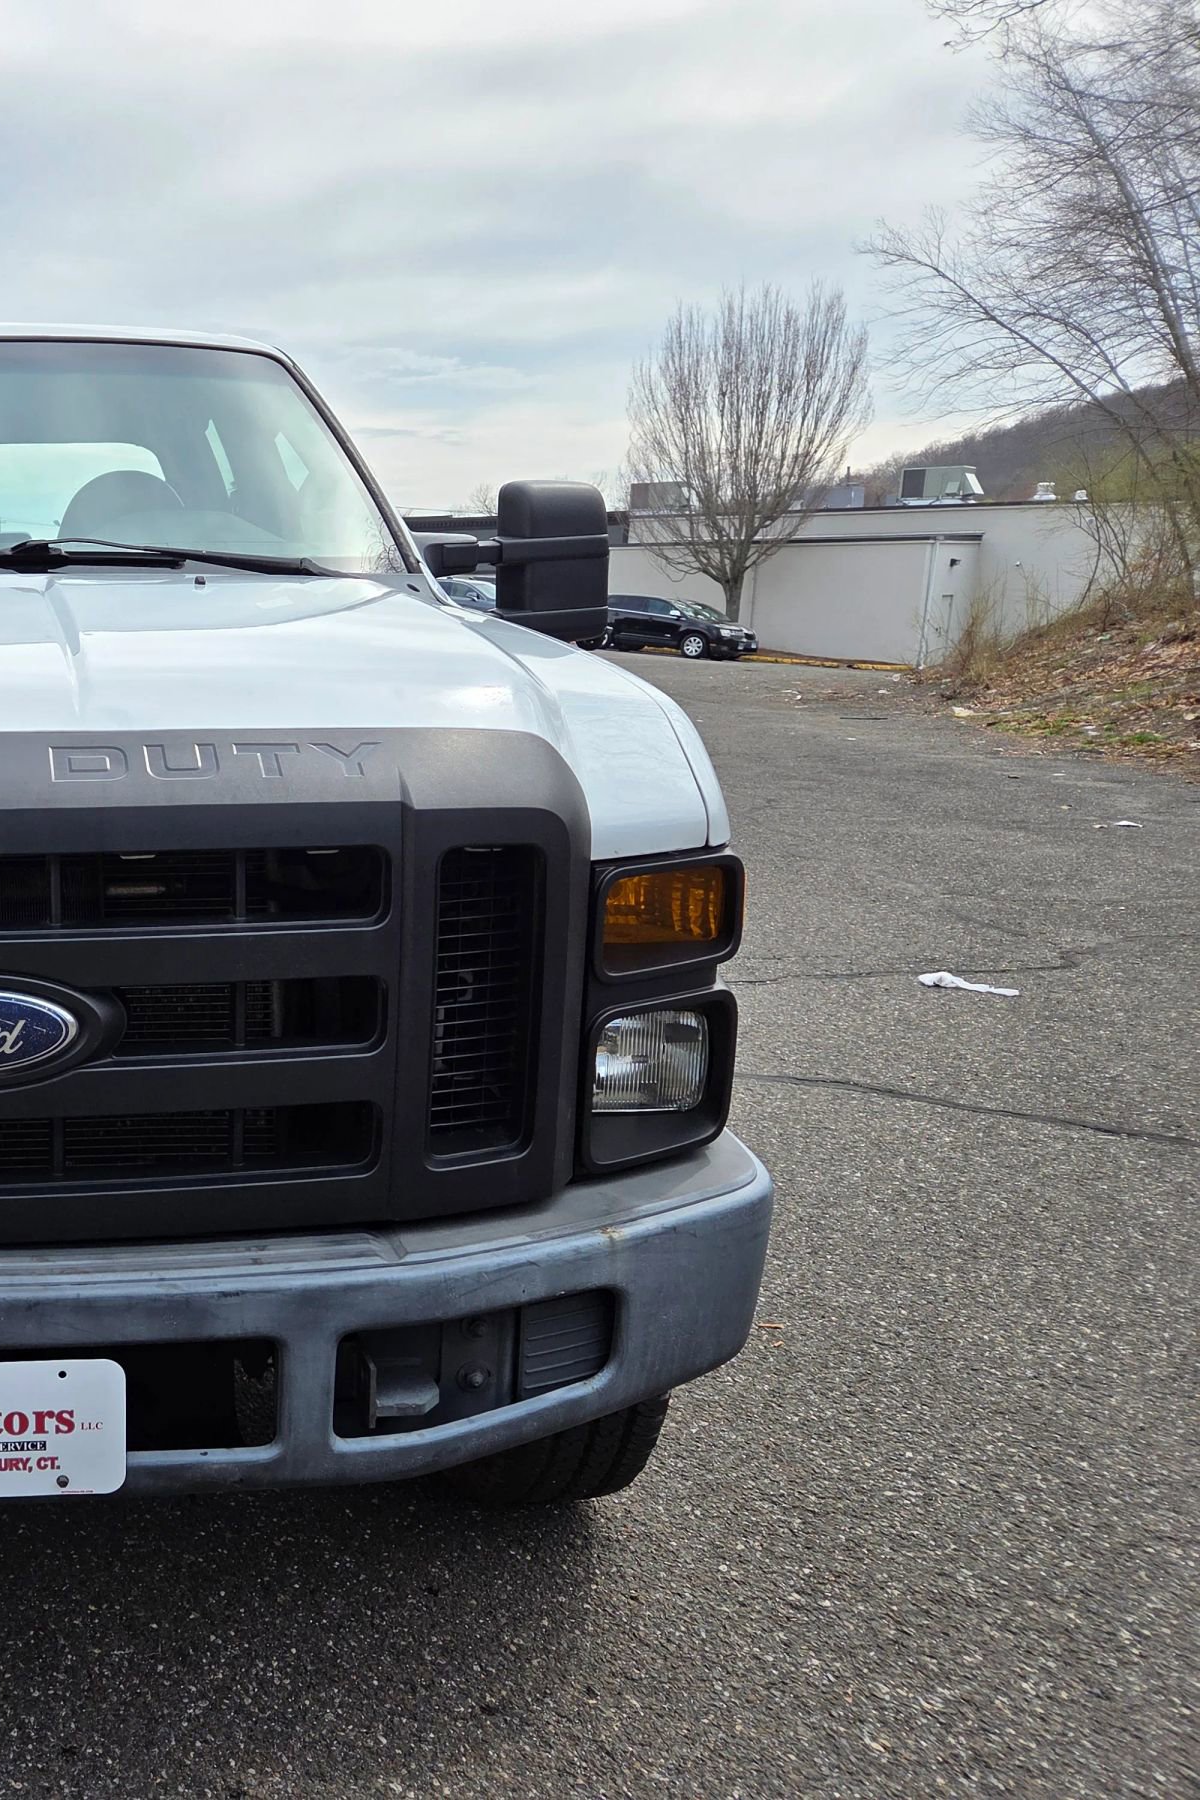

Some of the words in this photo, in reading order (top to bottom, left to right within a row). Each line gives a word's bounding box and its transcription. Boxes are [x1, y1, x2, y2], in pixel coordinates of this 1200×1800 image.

[49, 741, 383, 782] DUTY
[80, 1420, 104, 1431] LLC
[36, 1456, 61, 1470] CT.
